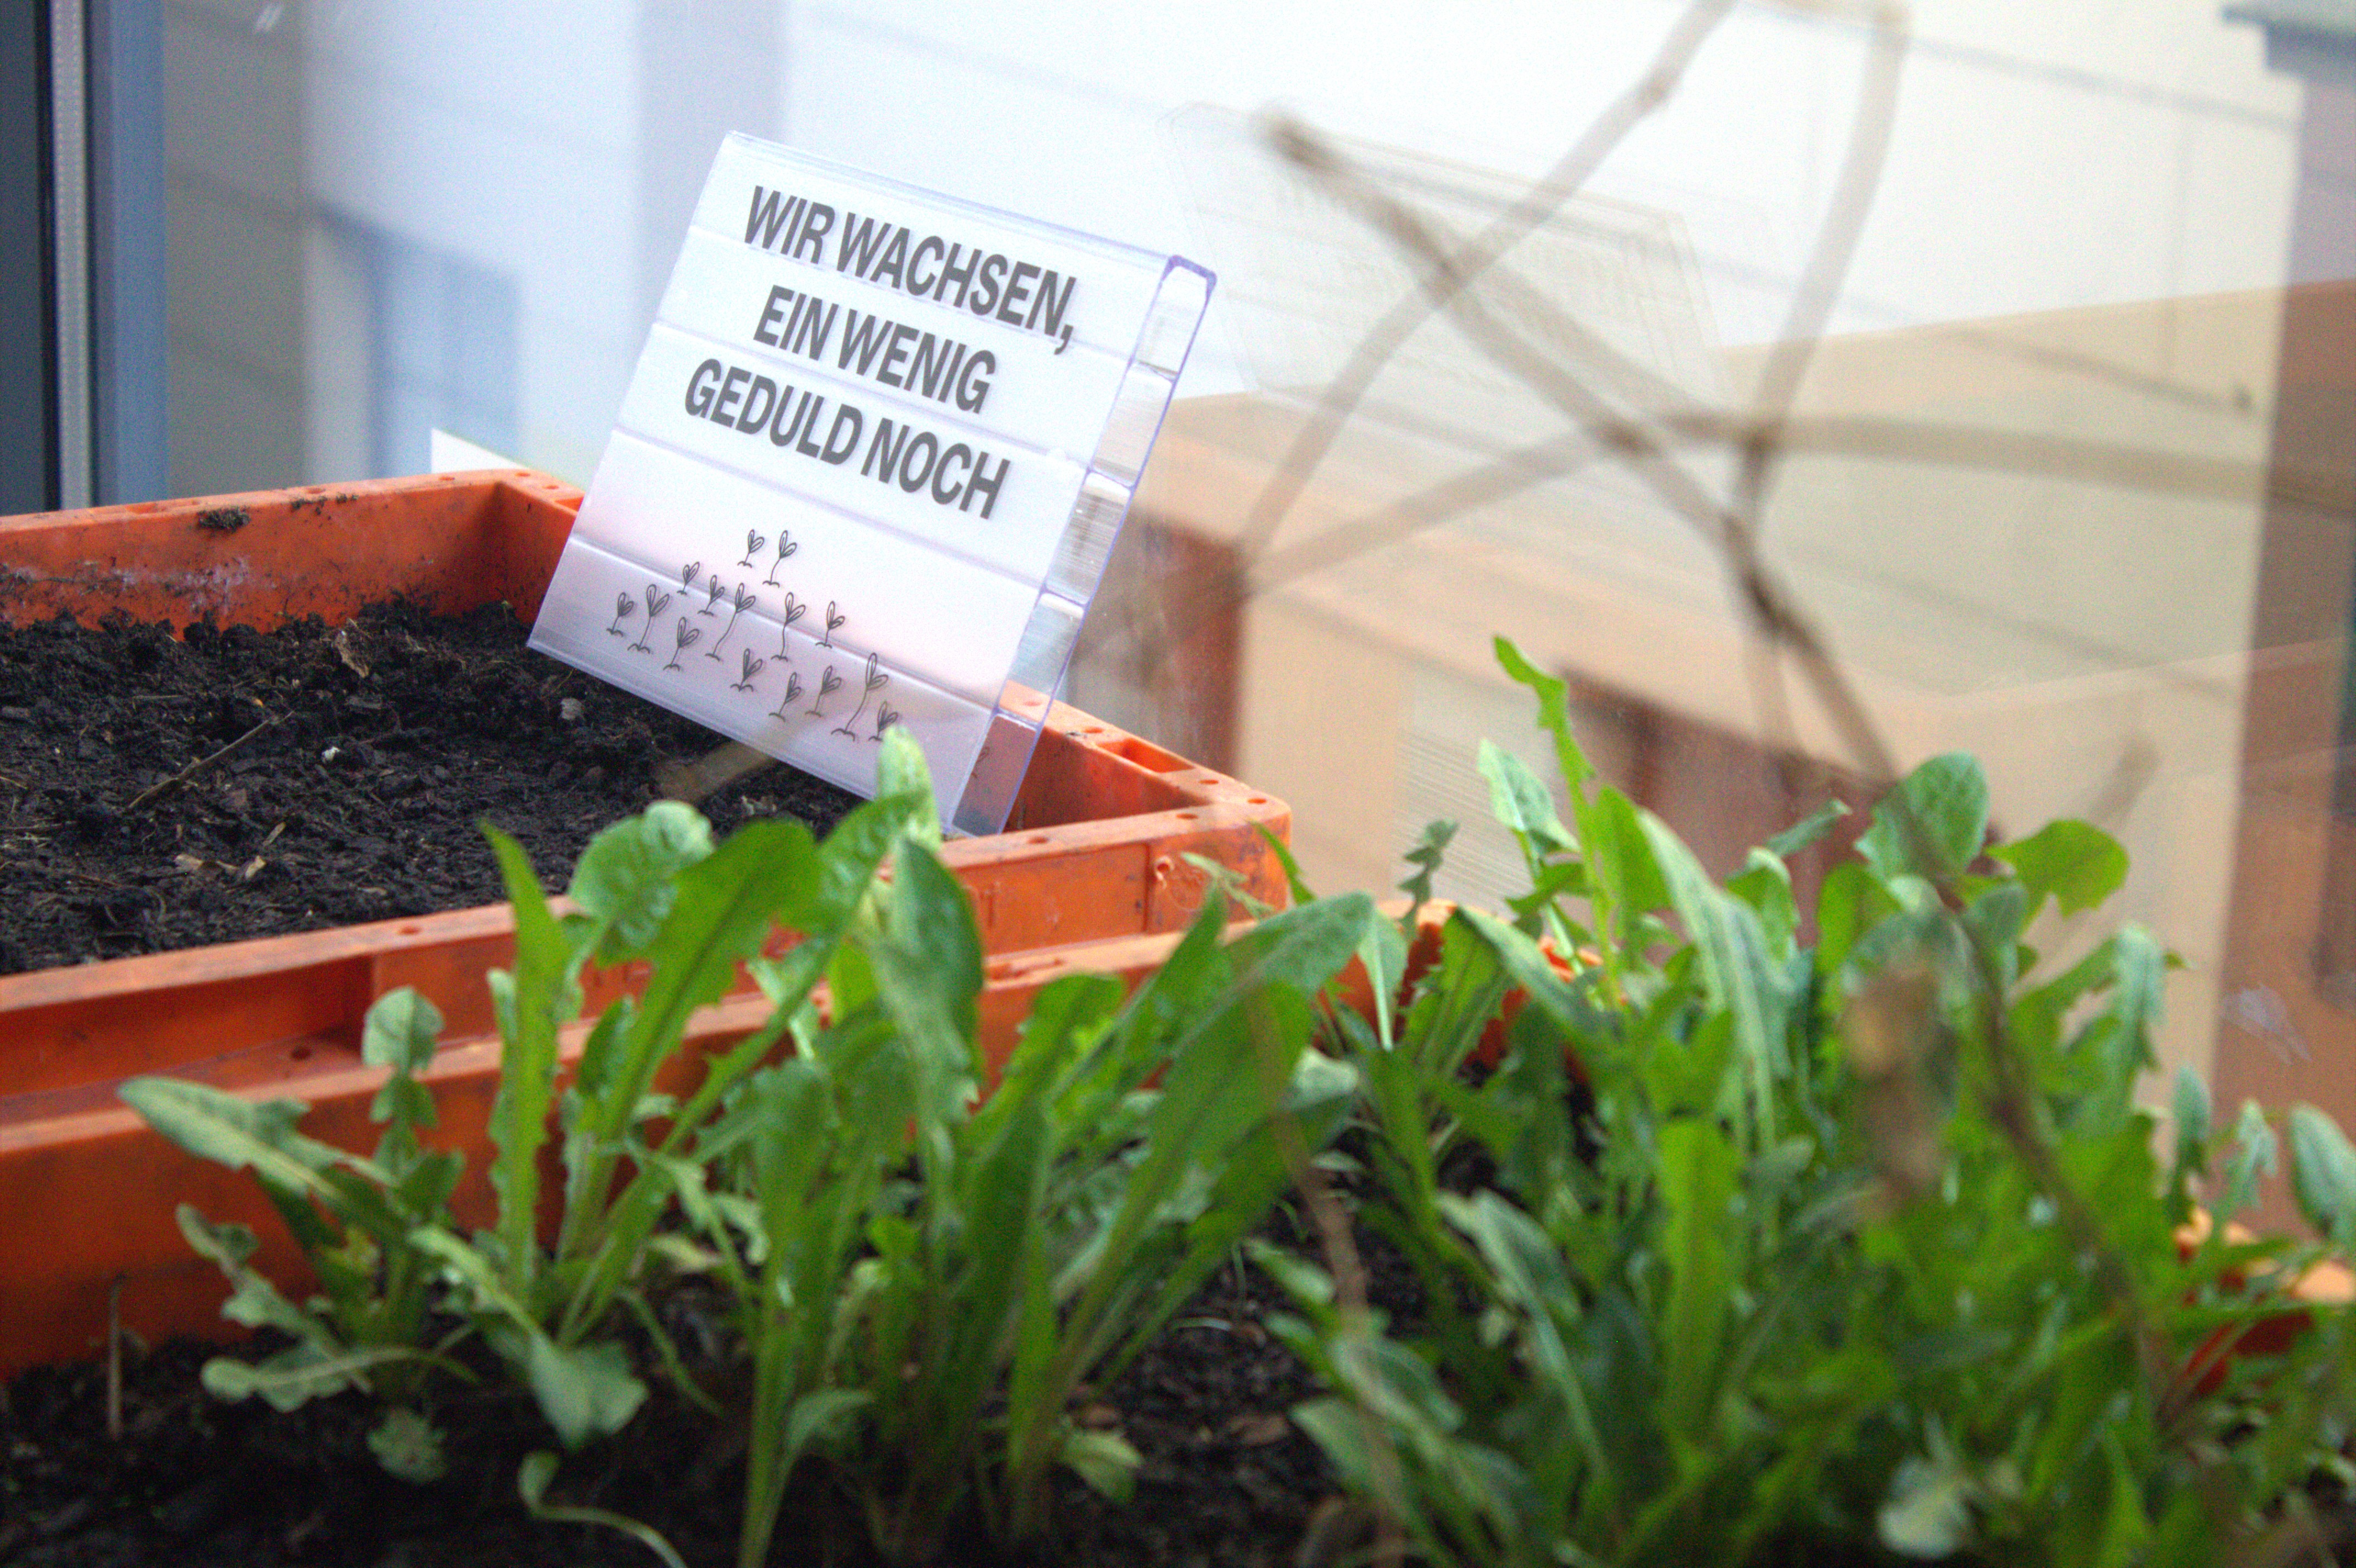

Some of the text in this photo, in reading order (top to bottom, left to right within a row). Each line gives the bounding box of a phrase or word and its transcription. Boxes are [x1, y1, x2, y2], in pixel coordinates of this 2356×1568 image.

[745, 186, 1076, 355] WIR WACHSEN,
[754, 285, 996, 415] EIN WENIG
[685, 359, 1010, 520] GEDULD NOCH
